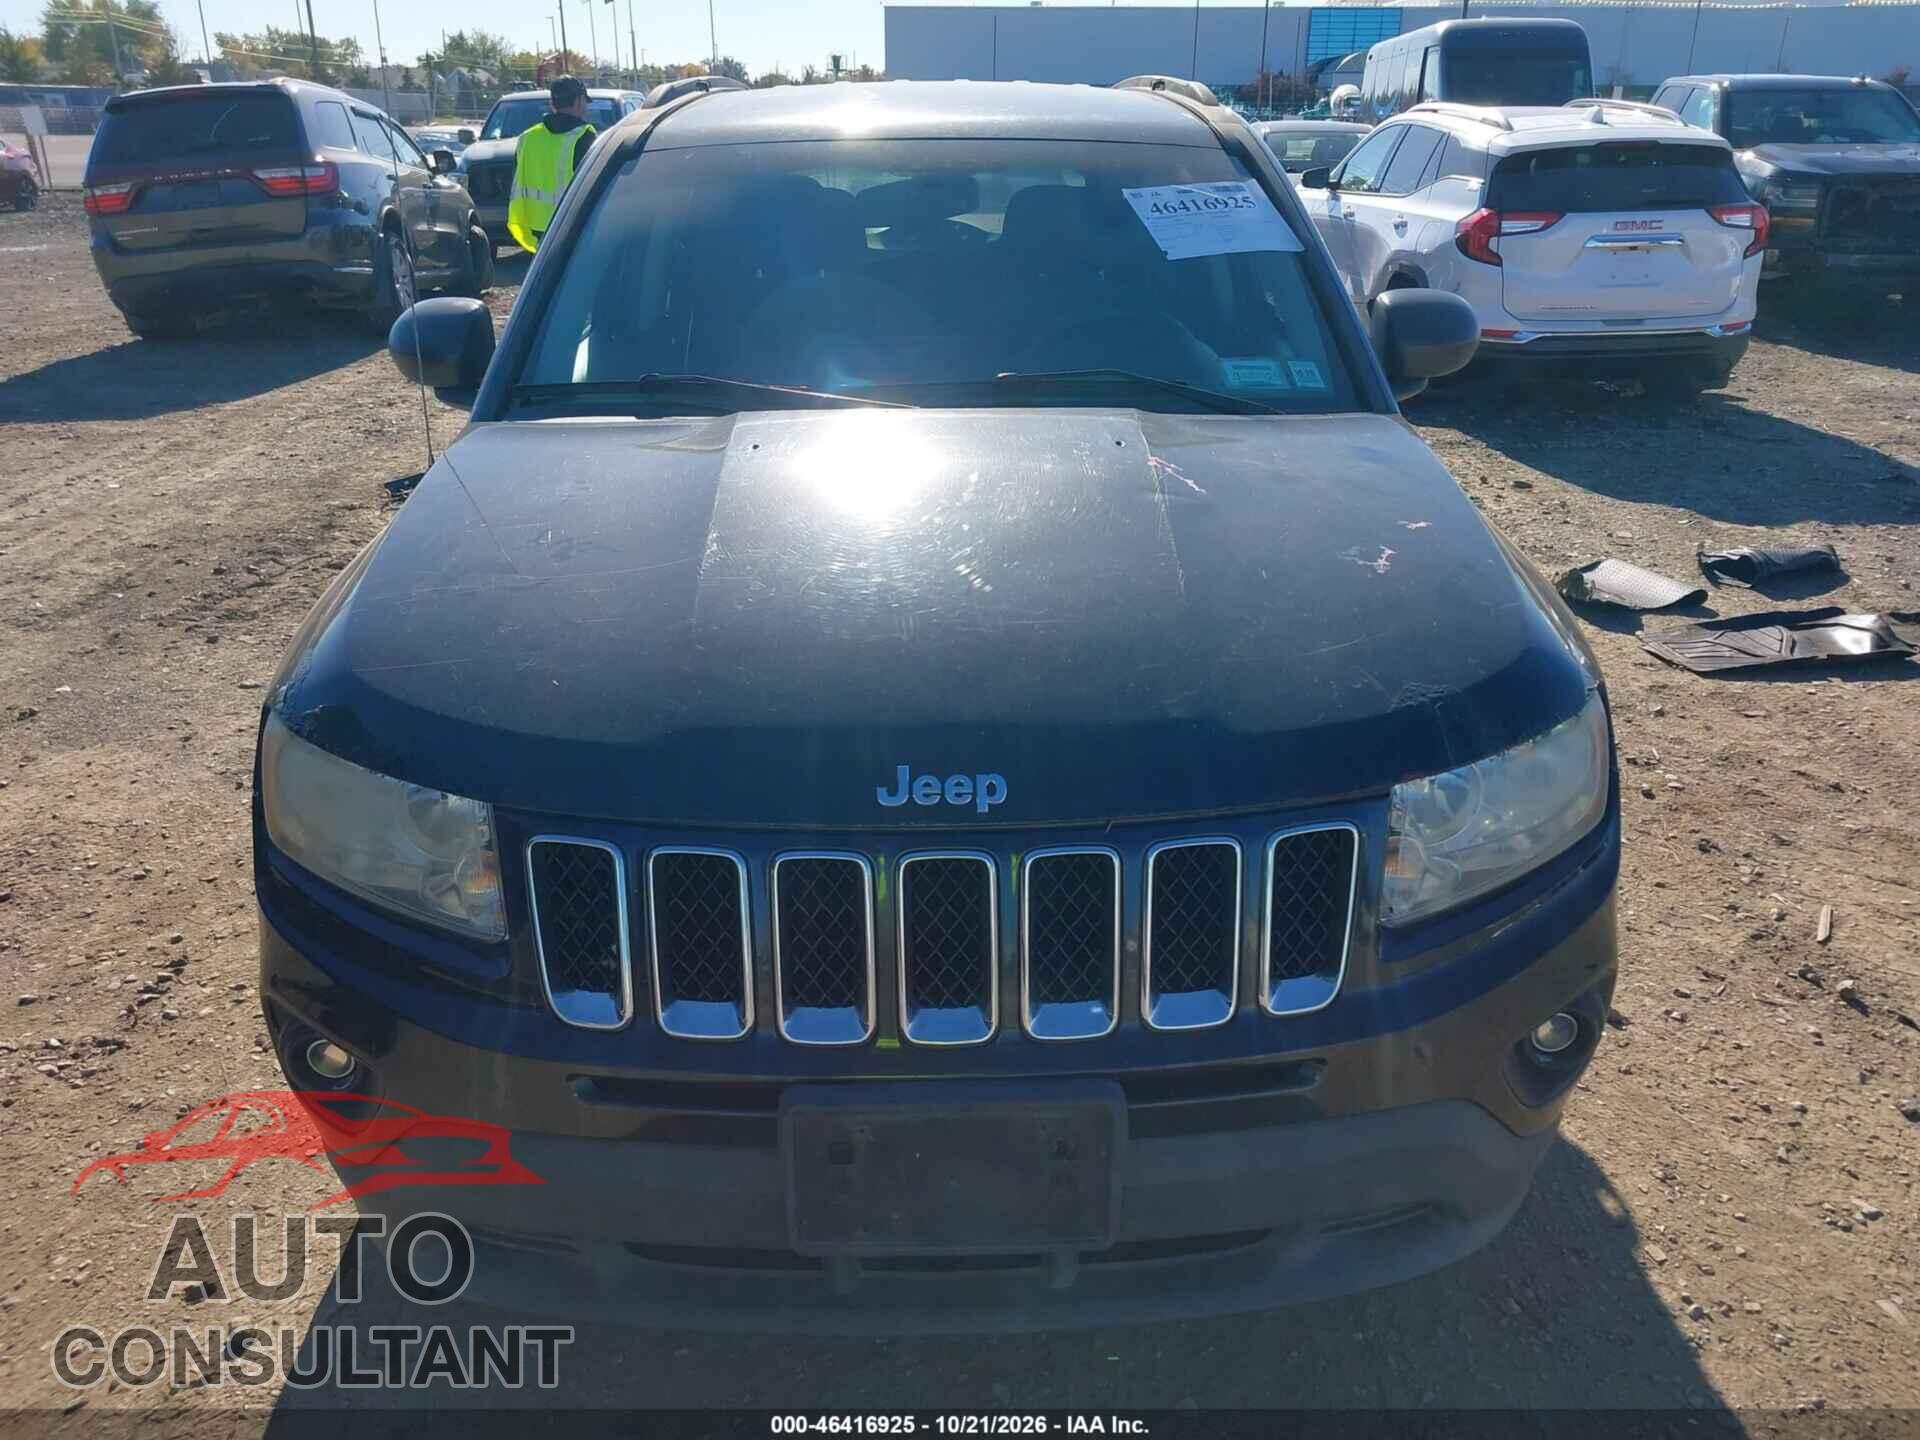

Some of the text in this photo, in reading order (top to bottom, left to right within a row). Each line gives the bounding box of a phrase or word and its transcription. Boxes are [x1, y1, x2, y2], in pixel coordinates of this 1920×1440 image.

[1150, 195, 1257, 215] 46416925
[1614, 219, 1664, 231] GMC
[876, 765, 1008, 813] Jeep
